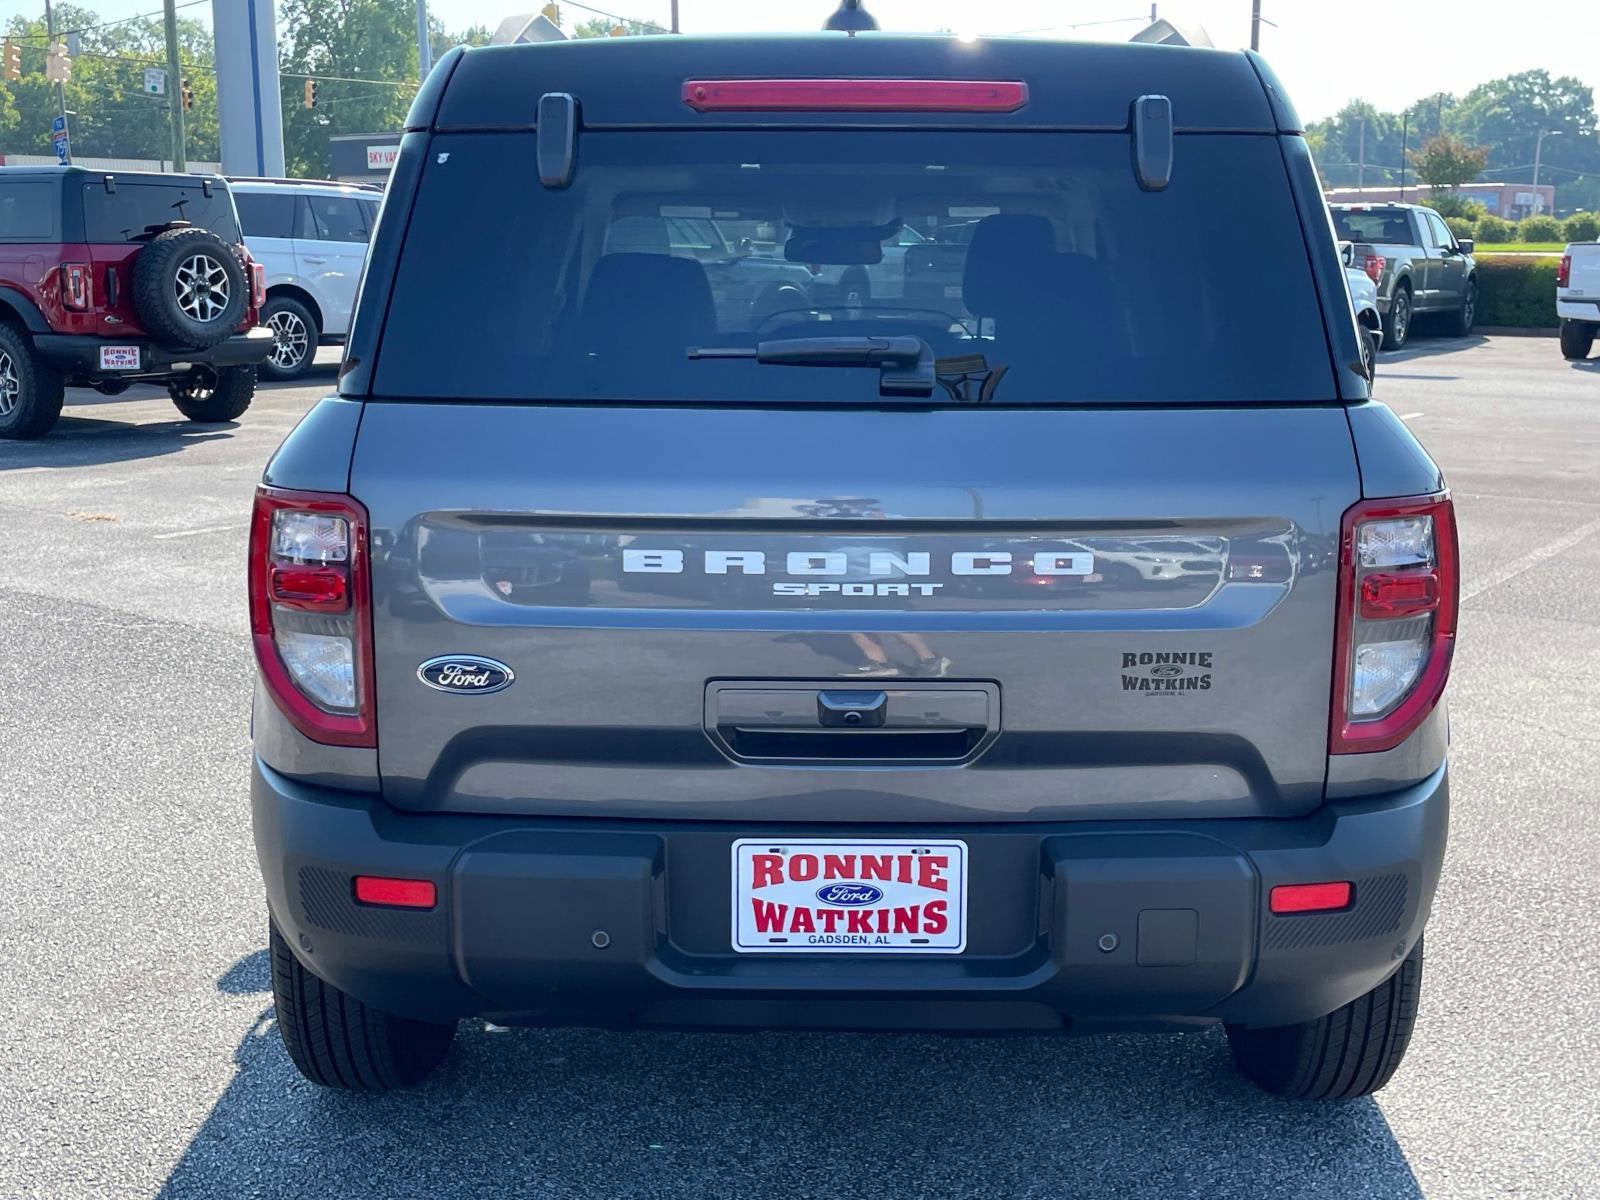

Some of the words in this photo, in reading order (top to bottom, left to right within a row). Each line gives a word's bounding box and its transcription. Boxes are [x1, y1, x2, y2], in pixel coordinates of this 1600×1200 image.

[369, 151, 382, 163] SKY
[104, 348, 137, 356] RONNIE
[104, 357, 137, 366] WATKINS
[623, 549, 1094, 575] BRONCO
[773, 582, 944, 596] SPORT
[1122, 652, 1212, 668] RONNIE
[438, 663, 490, 686] Ford
[1121, 674, 1211, 690] WATKINS
[752, 854, 948, 892] RONNIE
[827, 885, 873, 902] Ford
[752, 897, 948, 935] WATKINS
[808, 935, 871, 945] GADSDEN,
[874, 935, 891, 945] AL
